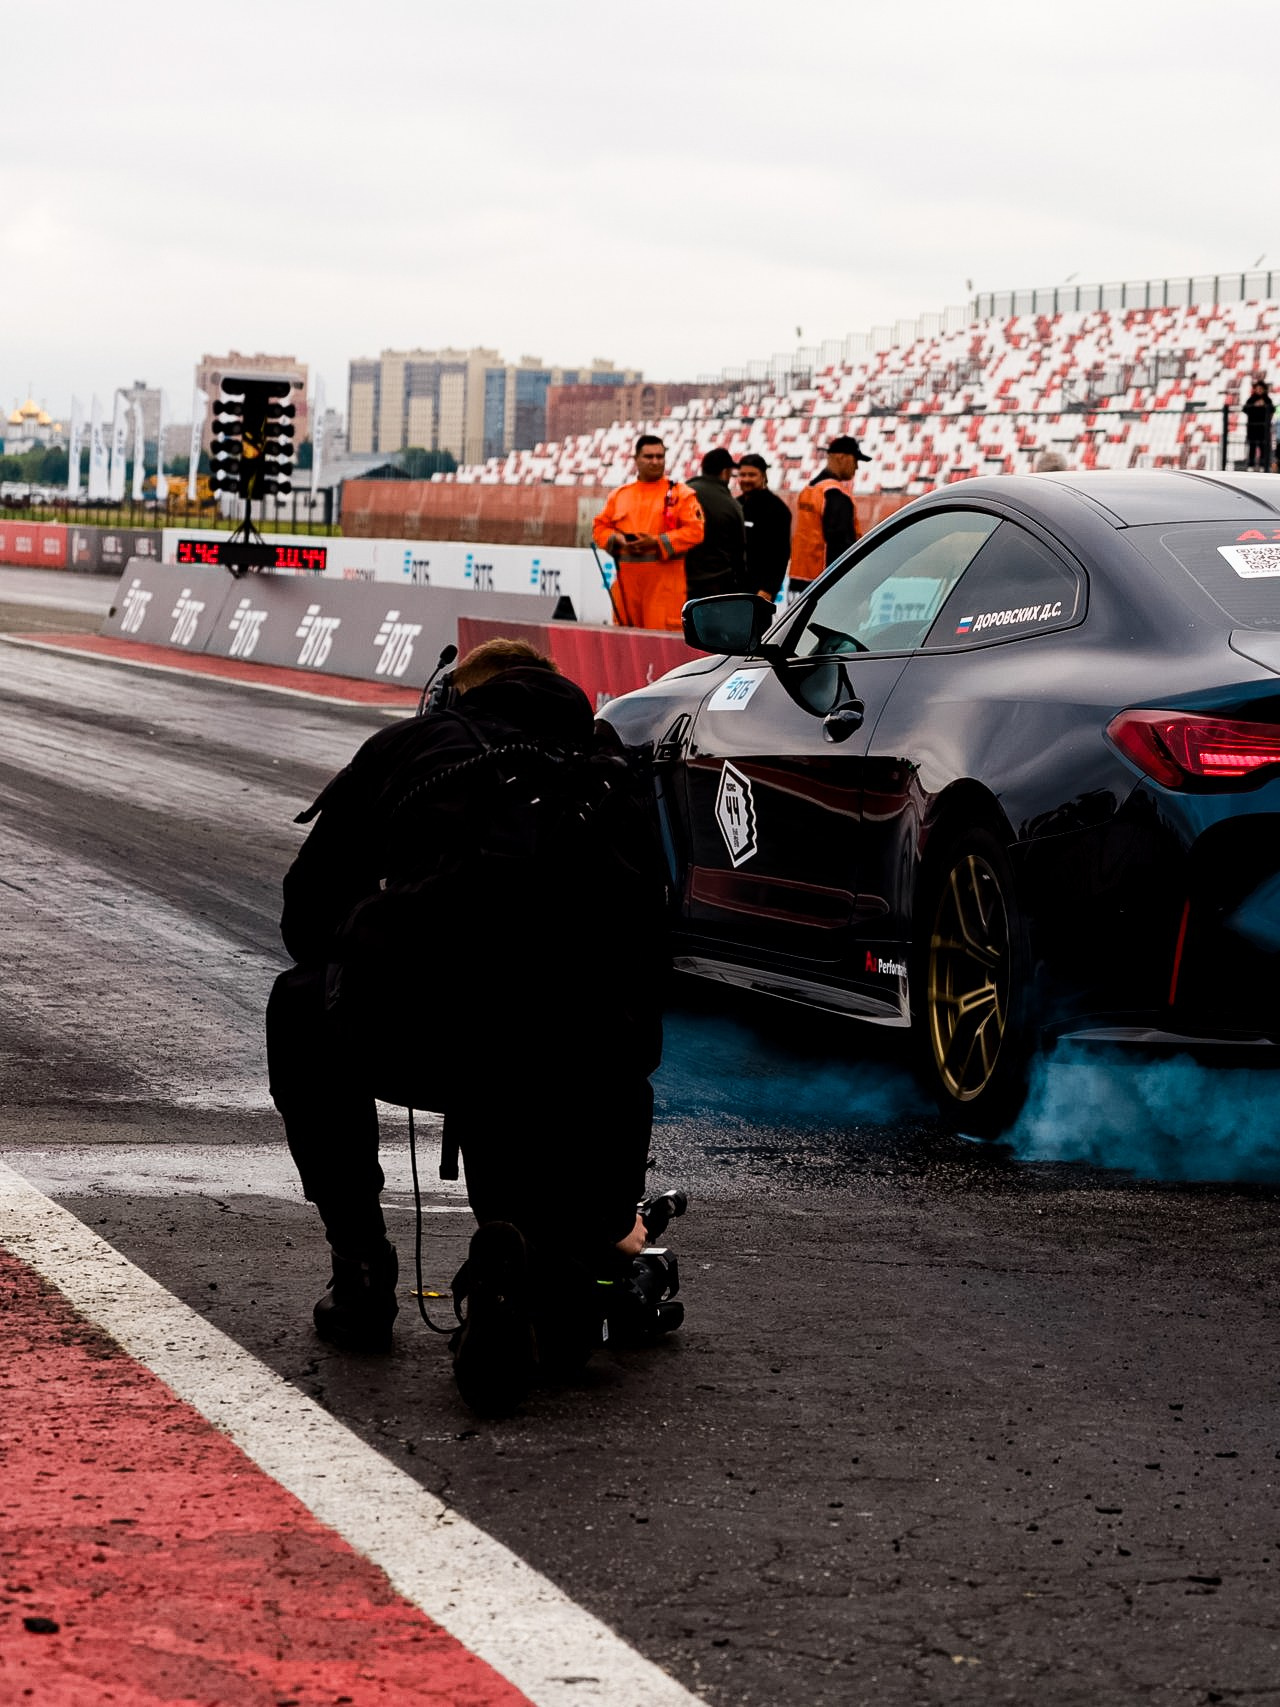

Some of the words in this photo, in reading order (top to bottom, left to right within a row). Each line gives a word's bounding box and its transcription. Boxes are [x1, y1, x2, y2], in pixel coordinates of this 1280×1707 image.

[121, 591, 152, 633] ВТБ
[170, 600, 205, 645] ВТБ
[972, 606, 1040, 632] ДОРОВСКИХ
[1038, 601, 1062, 621] Д.С.
[229, 611, 268, 657] ВТБ
[297, 617, 341, 667] ВТБ
[375, 623, 423, 677] ВТБ
[727, 680, 755, 700] ВТБ
[726, 795, 741, 826] 44
